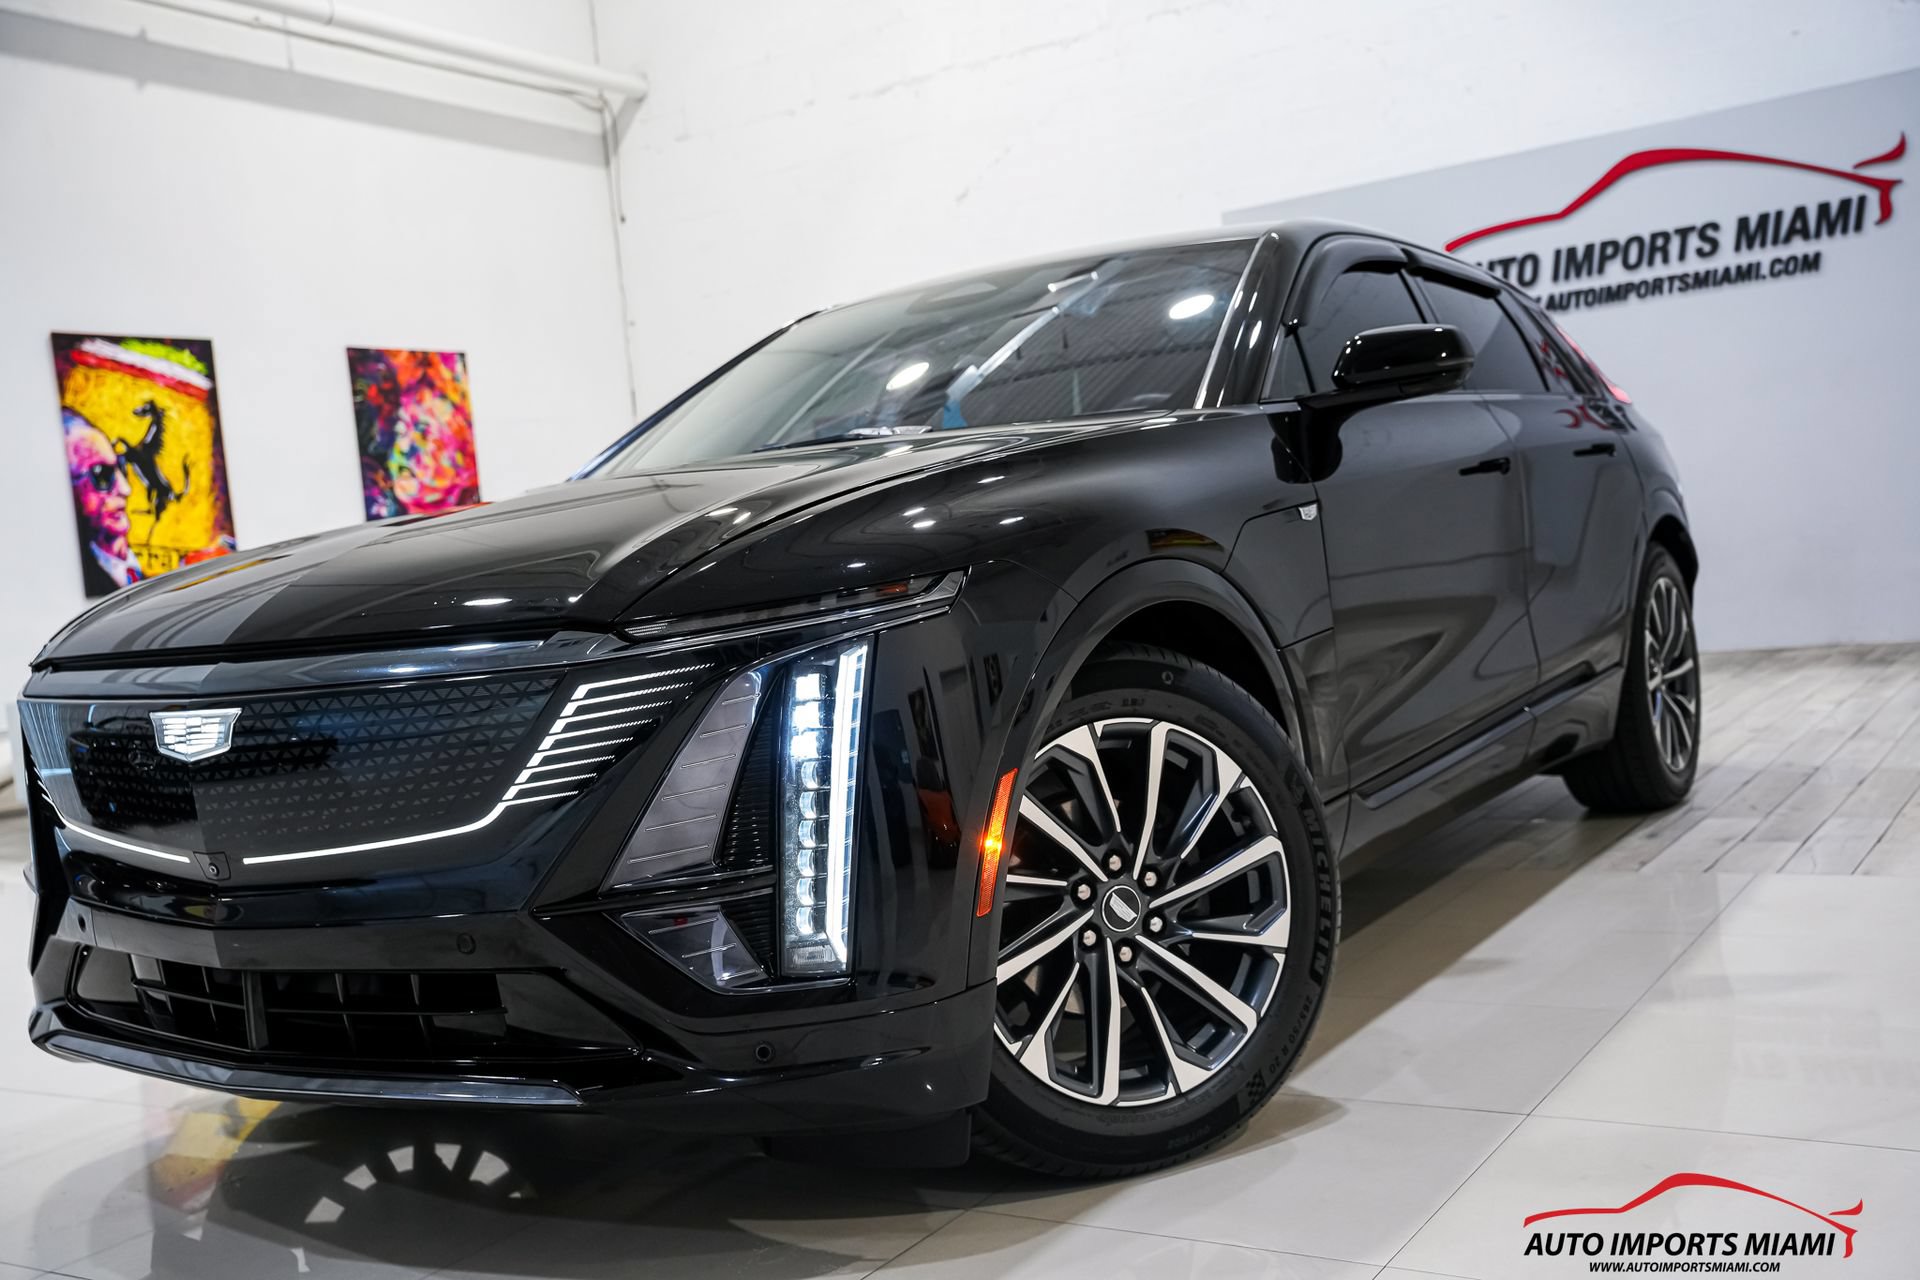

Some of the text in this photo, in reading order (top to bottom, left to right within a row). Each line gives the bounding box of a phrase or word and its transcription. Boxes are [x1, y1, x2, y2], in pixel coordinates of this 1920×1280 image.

[1477, 194, 1868, 288] TO IMPORTS MIAMI
[1535, 252, 1822, 313] AUTOIMPORTSMIAMI.COM
[1303, 807, 1333, 972] MICHELIN
